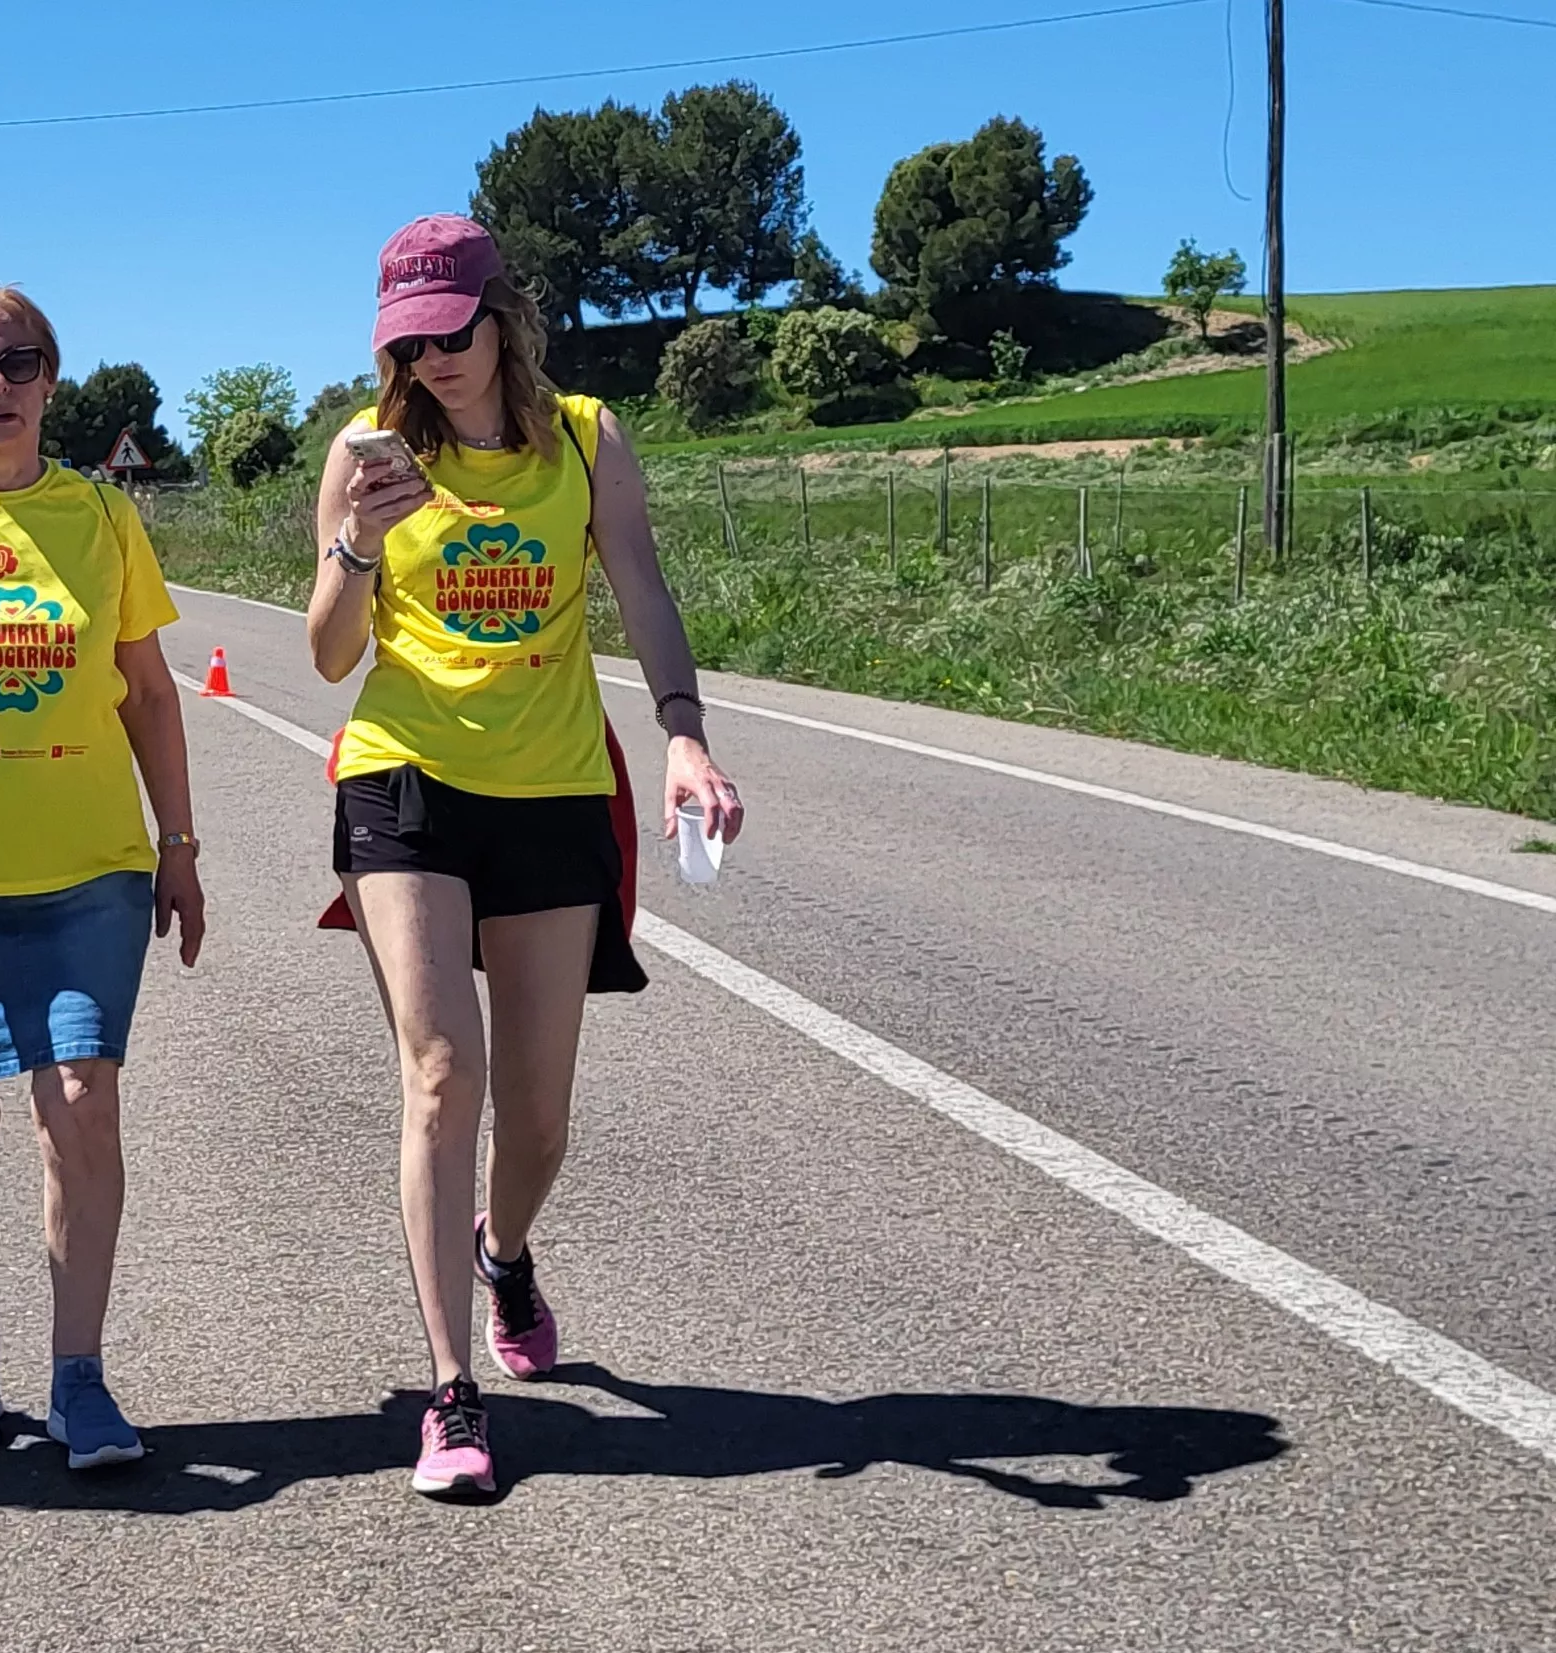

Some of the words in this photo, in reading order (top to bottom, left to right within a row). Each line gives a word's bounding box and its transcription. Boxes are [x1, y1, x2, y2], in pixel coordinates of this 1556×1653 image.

[436, 568, 458, 590] LA
[464, 567, 531, 588] SUERTE
[535, 565, 556, 588] DE
[436, 588, 552, 612] CONOCERNOS
[55, 623, 76, 645] DE
